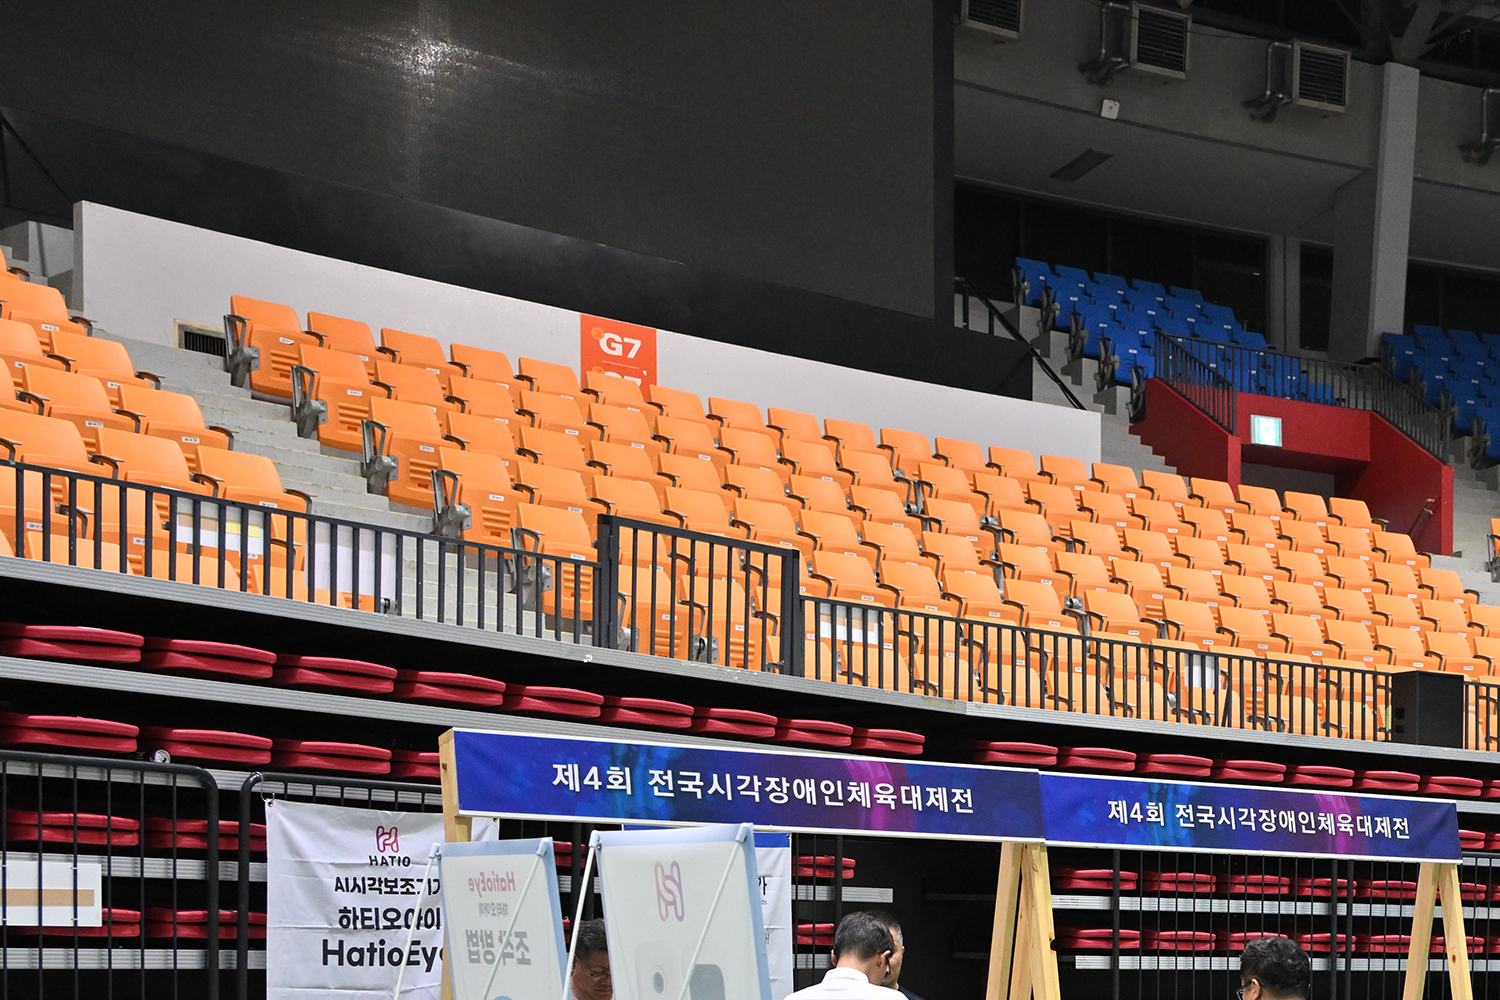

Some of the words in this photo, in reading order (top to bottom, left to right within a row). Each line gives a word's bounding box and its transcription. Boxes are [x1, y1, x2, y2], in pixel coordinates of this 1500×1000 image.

[600, 333, 641, 358] G7
[552, 761, 633, 795] 제4회
[647, 768, 975, 815] 전국시각장애인체육대제전
[1107, 799, 1165, 827] 제4회
[1175, 806, 1411, 840] 전국시각장애인체육대제전
[369, 855, 411, 867] HATIO
[338, 907, 440, 930] 하티오아이
